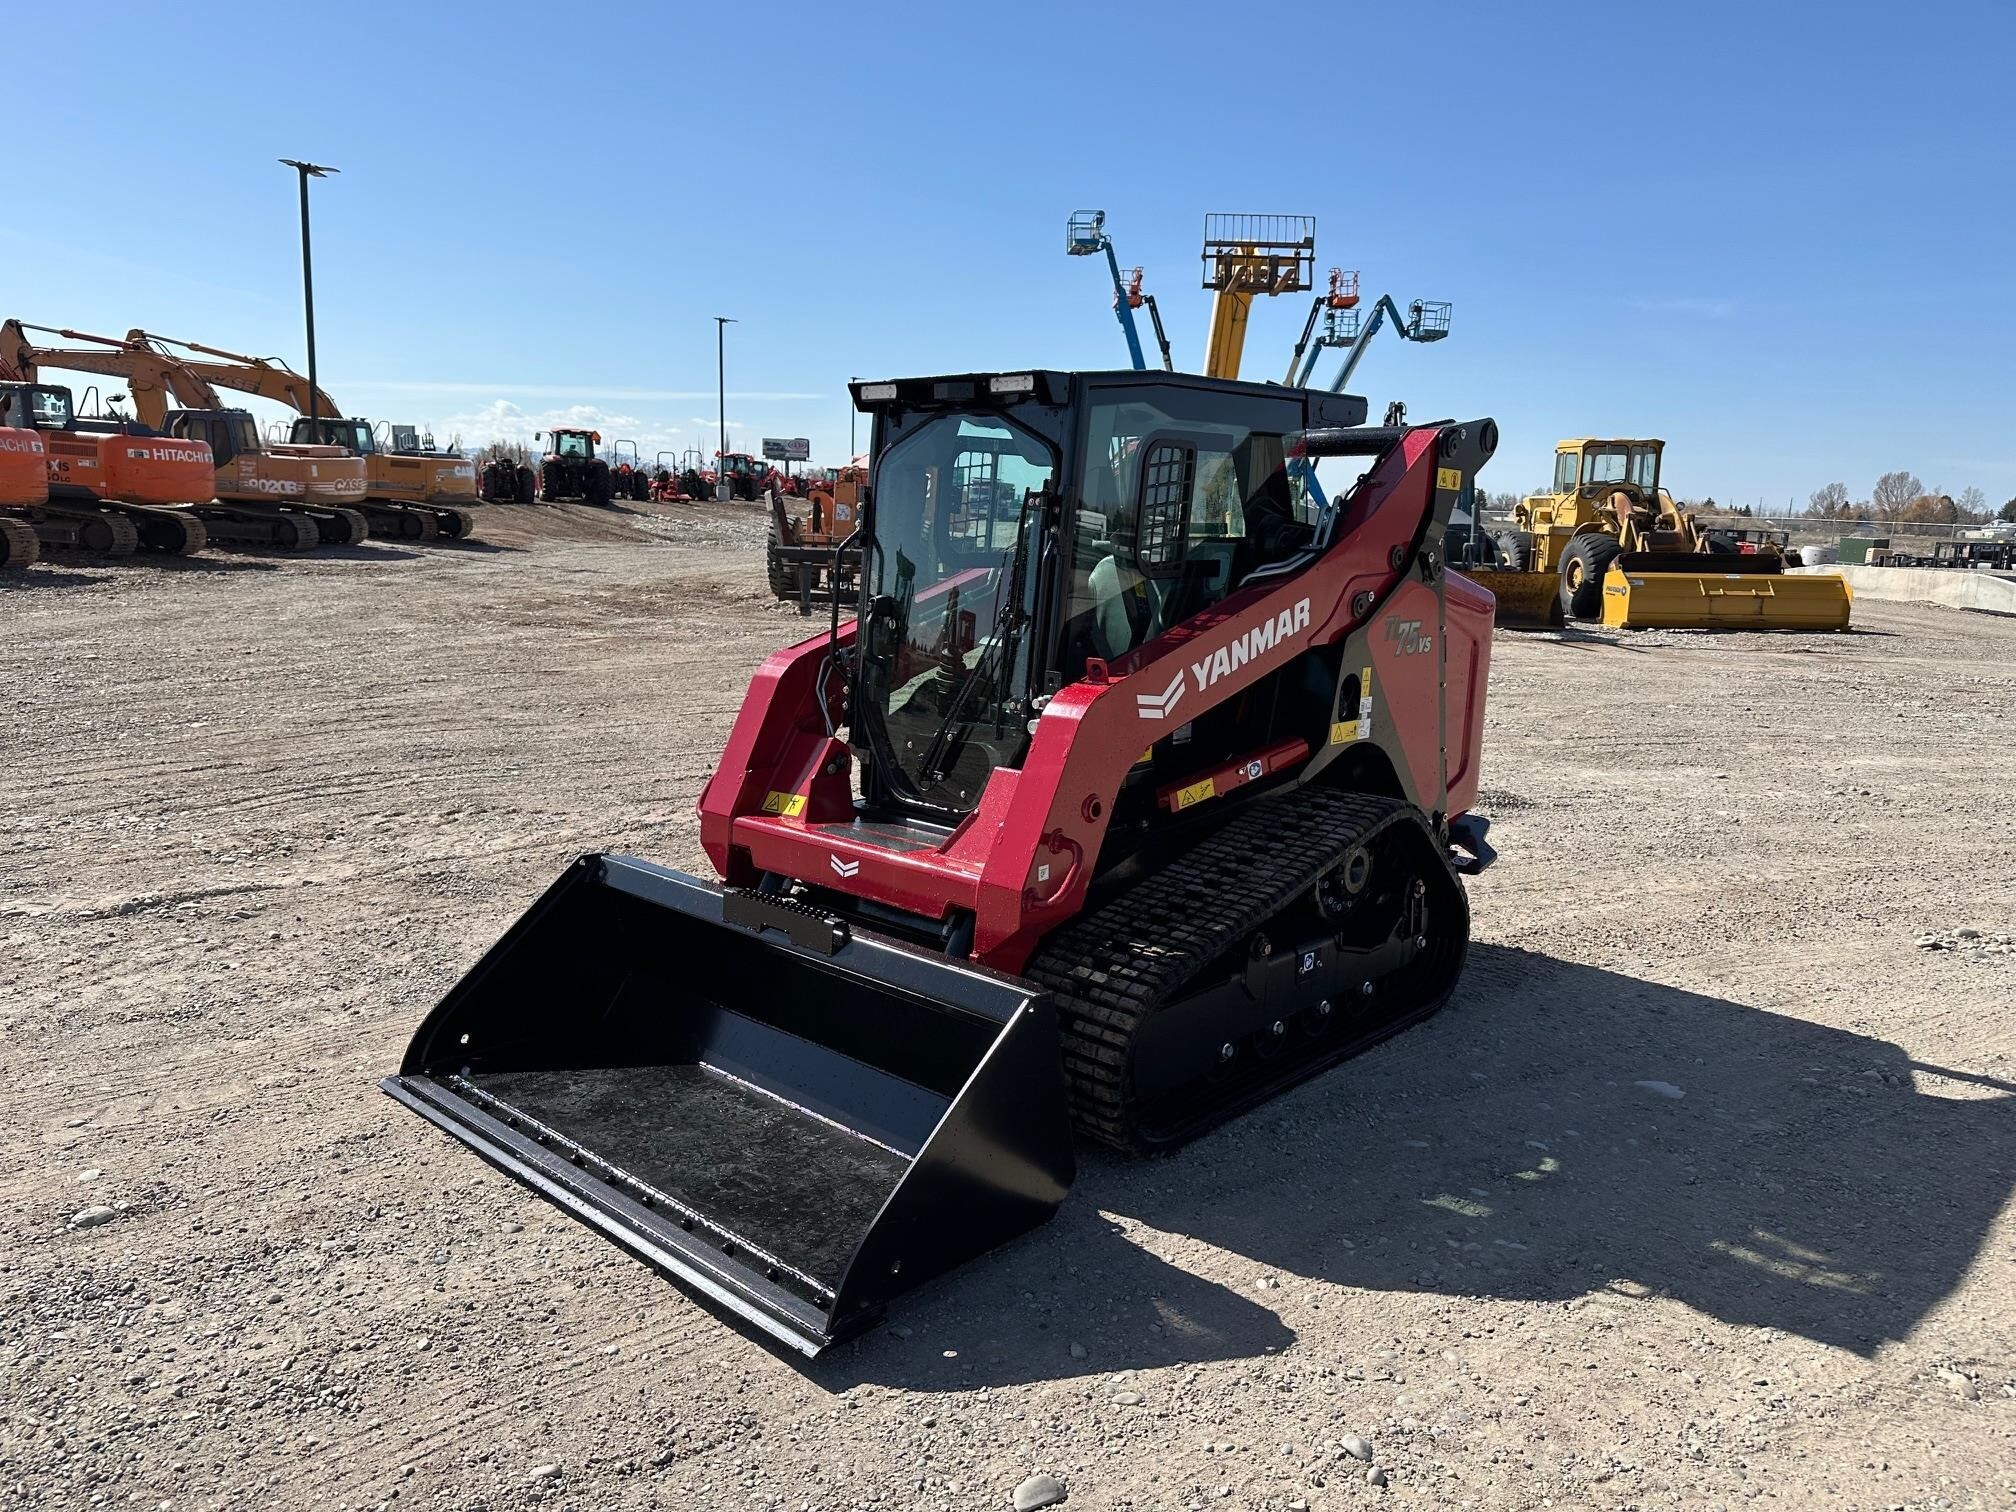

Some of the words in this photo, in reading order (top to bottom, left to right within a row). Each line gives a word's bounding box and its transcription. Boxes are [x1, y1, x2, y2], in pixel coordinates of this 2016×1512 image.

[152, 448, 204, 464] HITACHI
[334, 479, 364, 494] CASE
[1190, 597, 1310, 692] YANMAR
